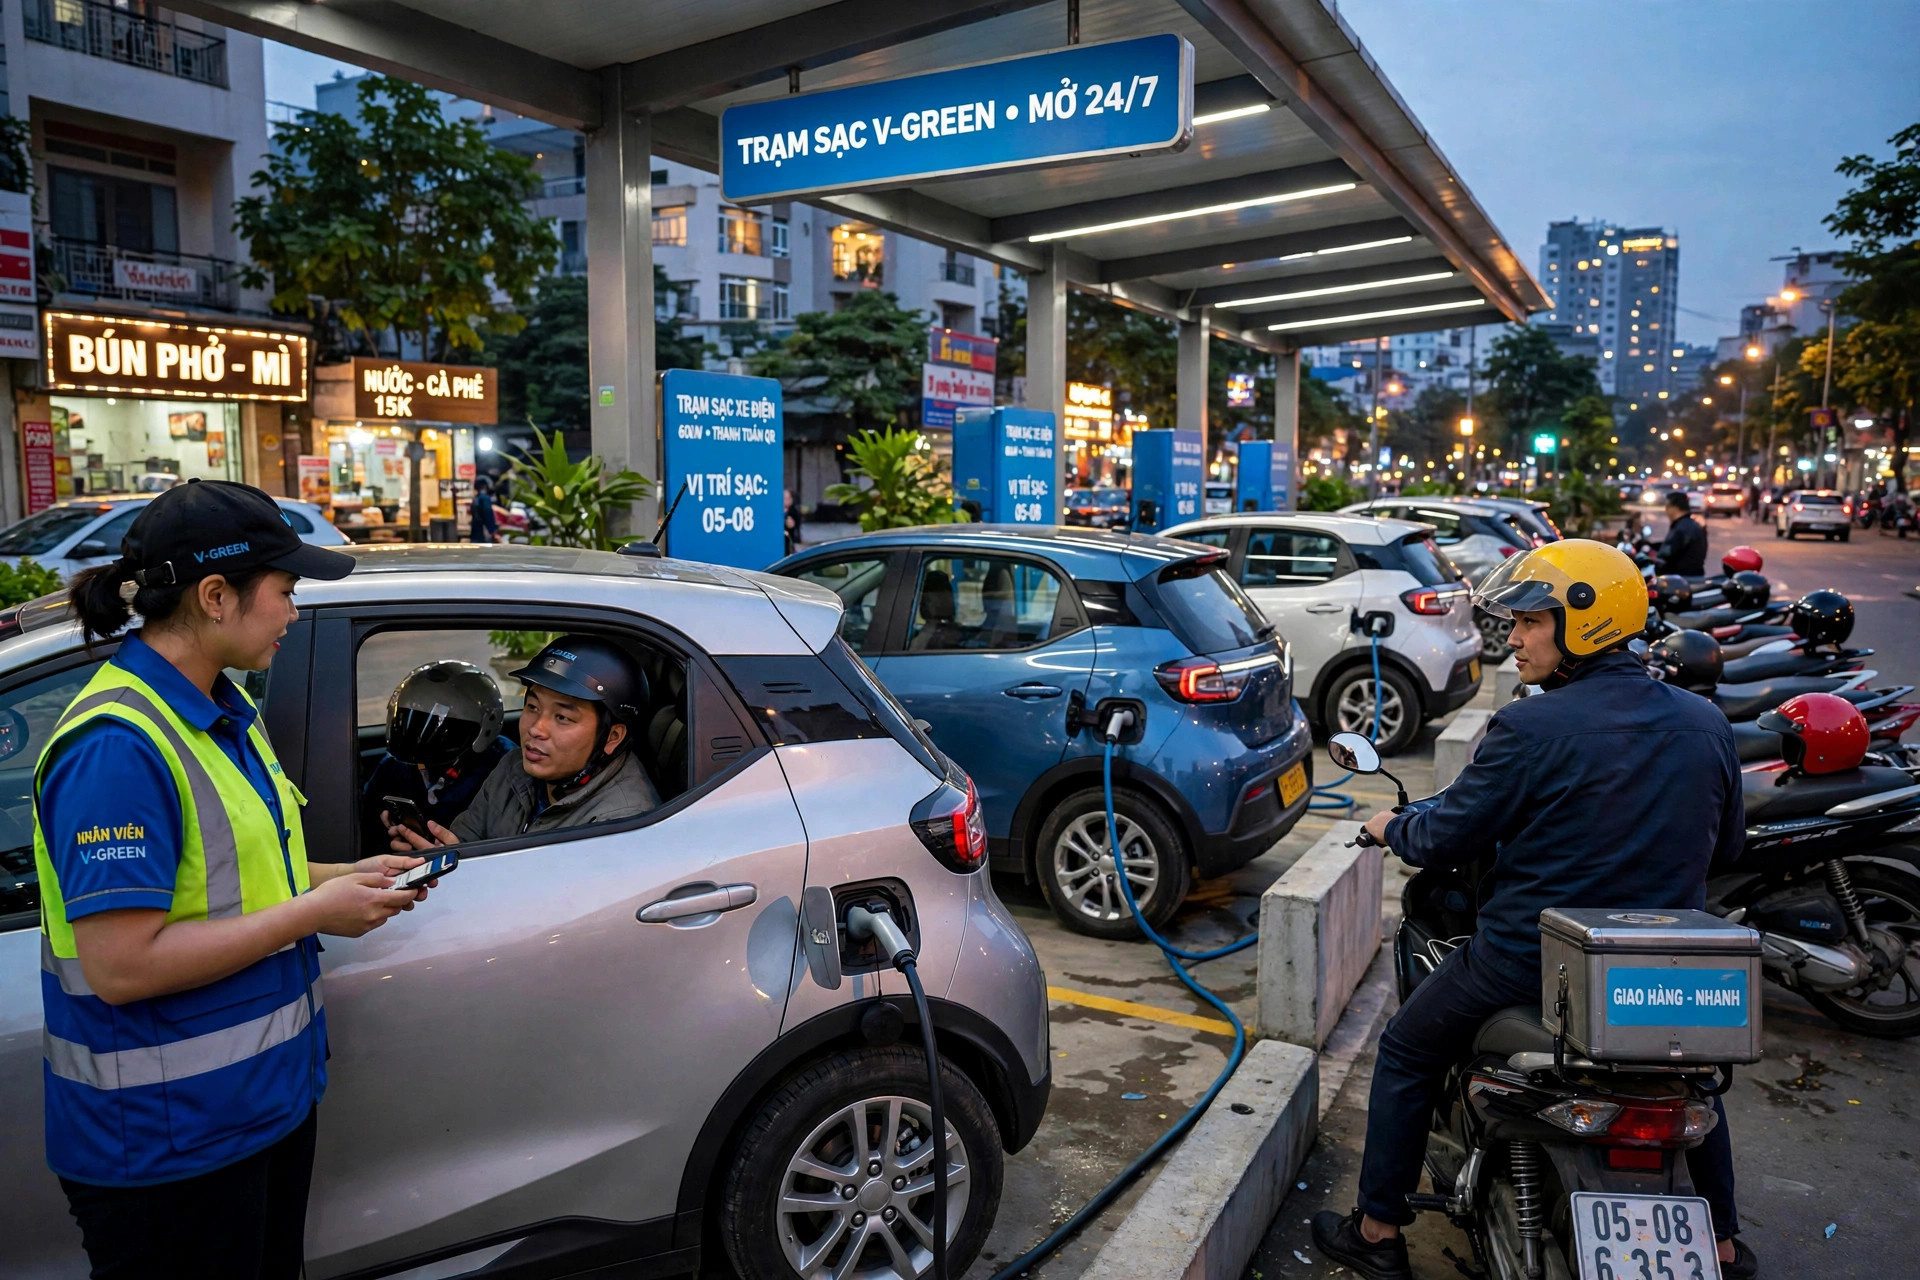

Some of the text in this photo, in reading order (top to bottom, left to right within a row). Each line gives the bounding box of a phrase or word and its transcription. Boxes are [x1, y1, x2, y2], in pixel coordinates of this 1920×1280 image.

[738, 75, 1159, 168] TRẠM SẠC V-GREEN MỞ 24/7
[68, 328, 148, 377] BÚN
[156, 334, 227, 382] PHỞ
[252, 344, 291, 387] MÌ
[374, 395, 413, 418] 15K
[676, 394, 710, 420] TRẠM
[711, 397, 735, 422] SẠC
[735, 399, 751, 418] XE
[686, 467, 769, 502] VỊ TRÍ SẠC:
[702, 506, 754, 533] 05-08
[193, 541, 250, 563] V-GREEN
[80, 845, 146, 865] V-GREEN
[1613, 987, 1645, 1006] GIAO
[1647, 983, 1684, 1006] HÀNG
[1695, 989, 1741, 1006] NHANH
[1592, 1200, 1694, 1246] 05-08
